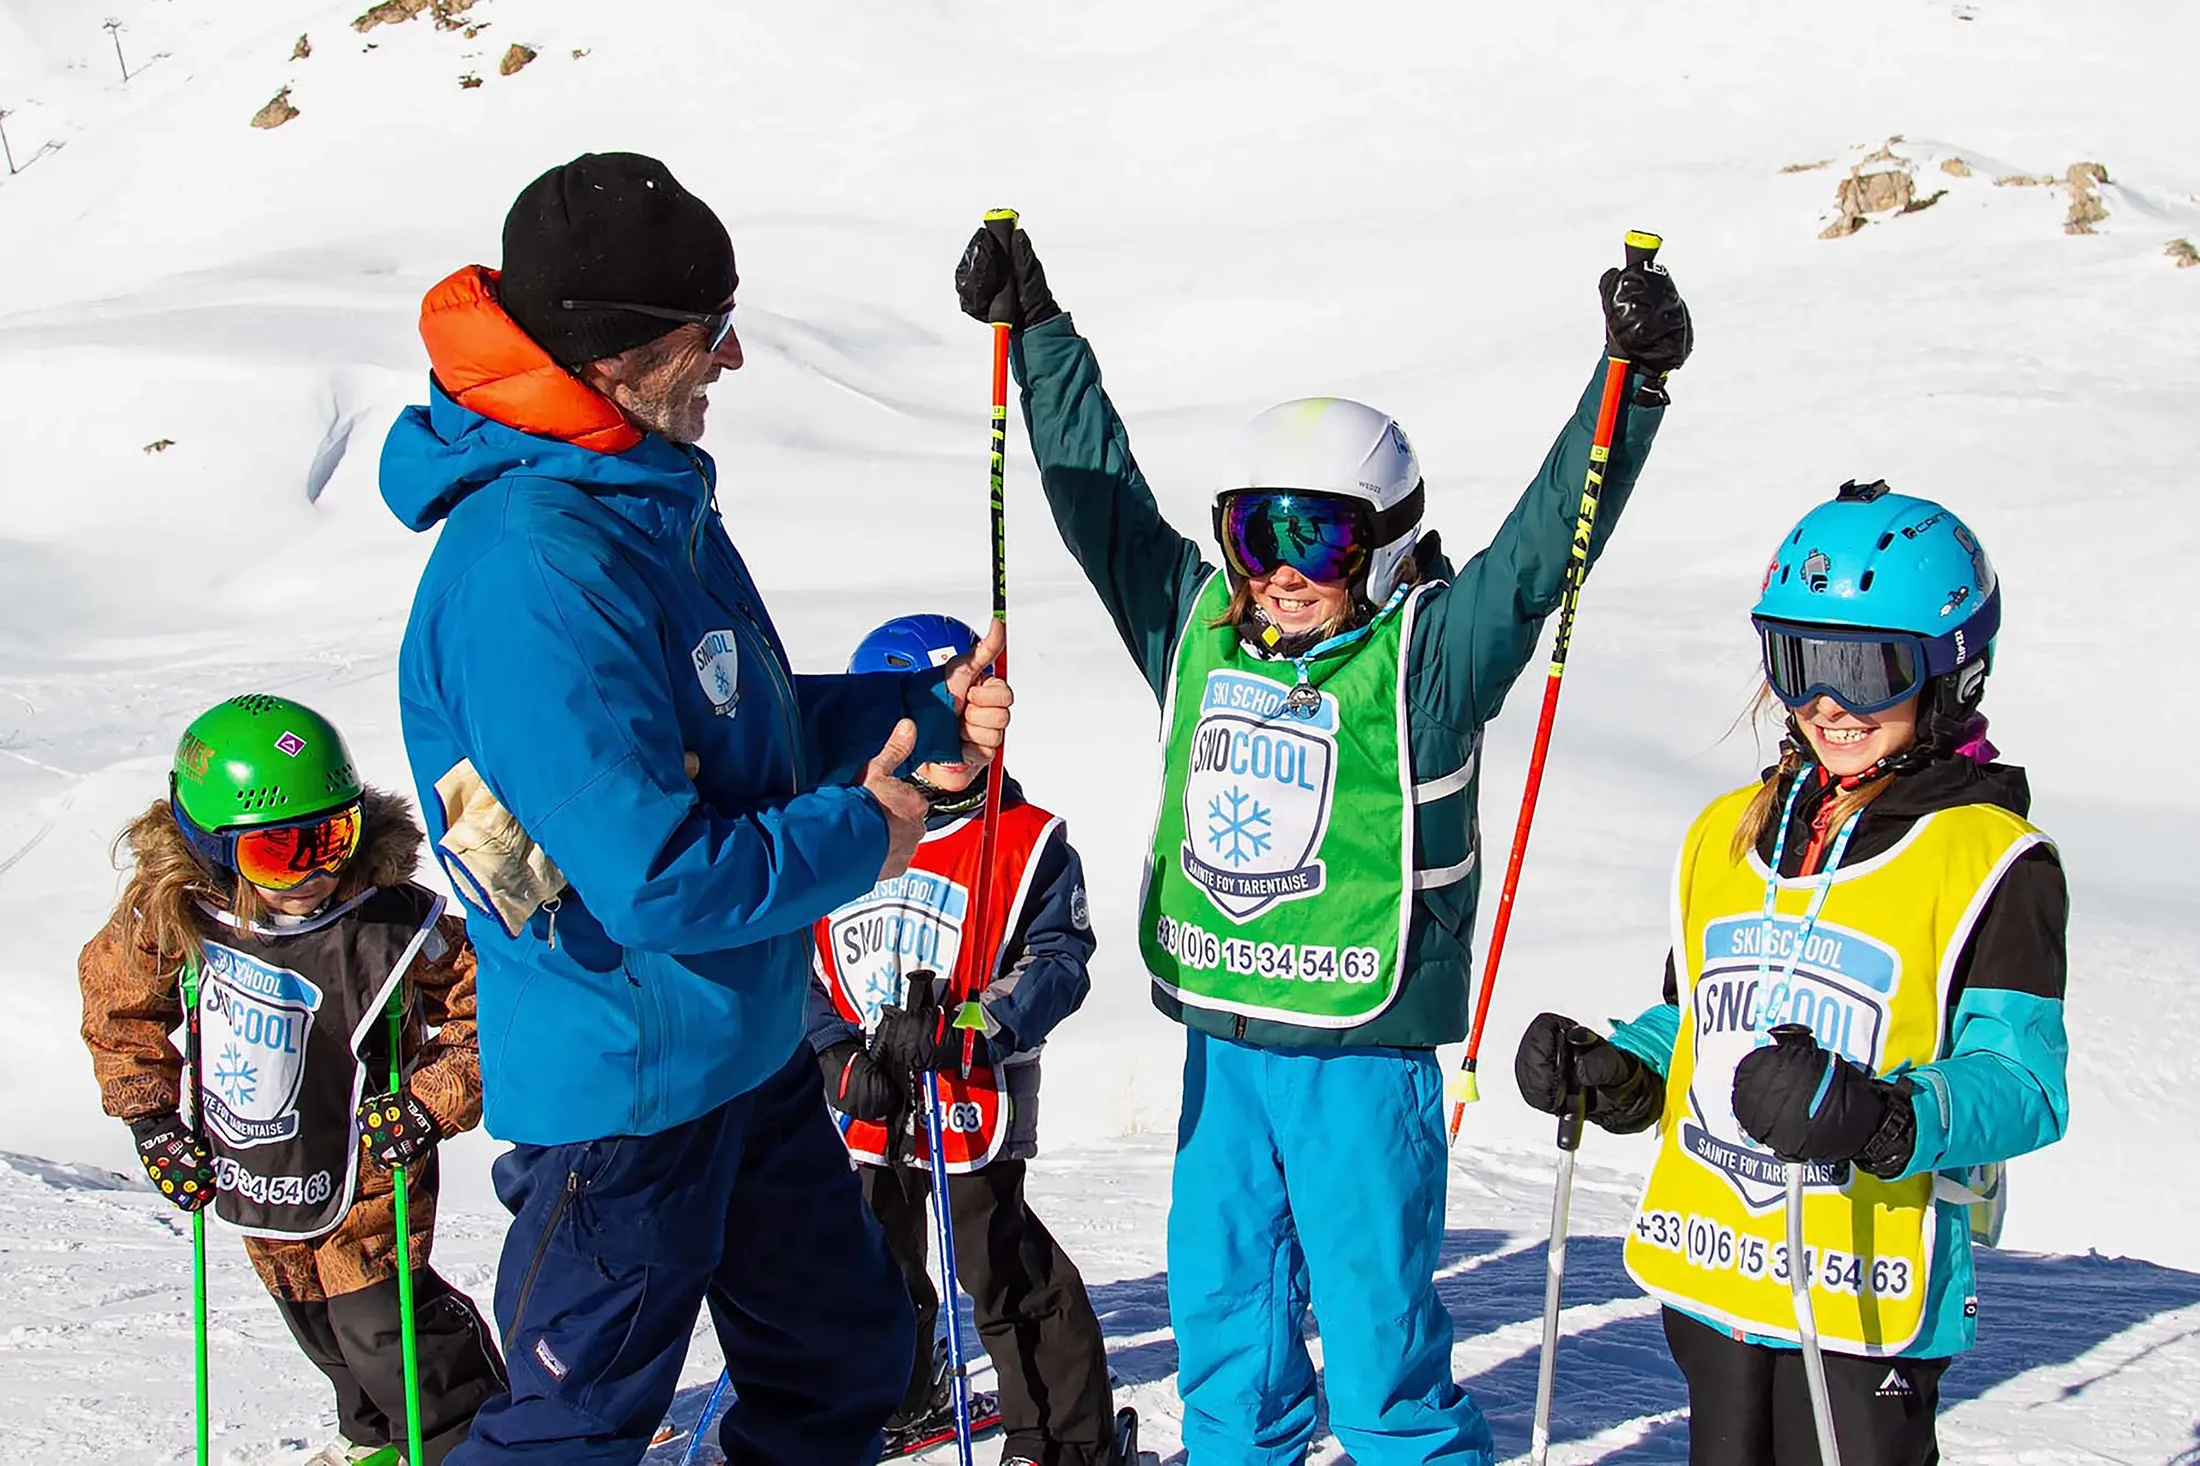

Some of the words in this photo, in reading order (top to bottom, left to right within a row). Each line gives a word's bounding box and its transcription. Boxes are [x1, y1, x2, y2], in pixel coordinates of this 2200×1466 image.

[1572, 469, 1602, 560] LEKI
[1213, 682, 1230, 705] SKI
[1231, 684, 1286, 717] SCHO
[1194, 728, 1315, 791] SNOCOOL
[881, 879, 934, 903] SCHOOL
[1188, 858, 1215, 887] SAINTE
[1216, 874, 1235, 893] FOY
[1237, 872, 1309, 895] TARENTAISE
[1180, 926, 1216, 965] (0)6
[1225, 942, 1252, 970] 15
[1260, 947, 1293, 975] 34
[1302, 950, 1335, 978] 54
[1343, 951, 1376, 979] 63
[1732, 926, 1762, 955] SKI
[1769, 928, 1842, 969] SCOOL
[407, 1100, 432, 1133] LEVEL
[952, 1103, 980, 1130] 63
[140, 1131, 175, 1150] LEVEL
[1697, 1138, 1737, 1170] SAINTE
[1739, 1155, 1760, 1177] FOY
[1761, 1160, 1836, 1184] TARETAIS
[240, 1170, 265, 1199] 34
[268, 1180, 299, 1201] 54
[307, 1174, 328, 1199] 63
[1636, 1214, 1681, 1248] +33
[1687, 1218, 1732, 1264] (0)6
[1740, 1237, 1764, 1274] 15
[1824, 1253, 1862, 1290] 54
[1872, 1260, 1908, 1294] 63
